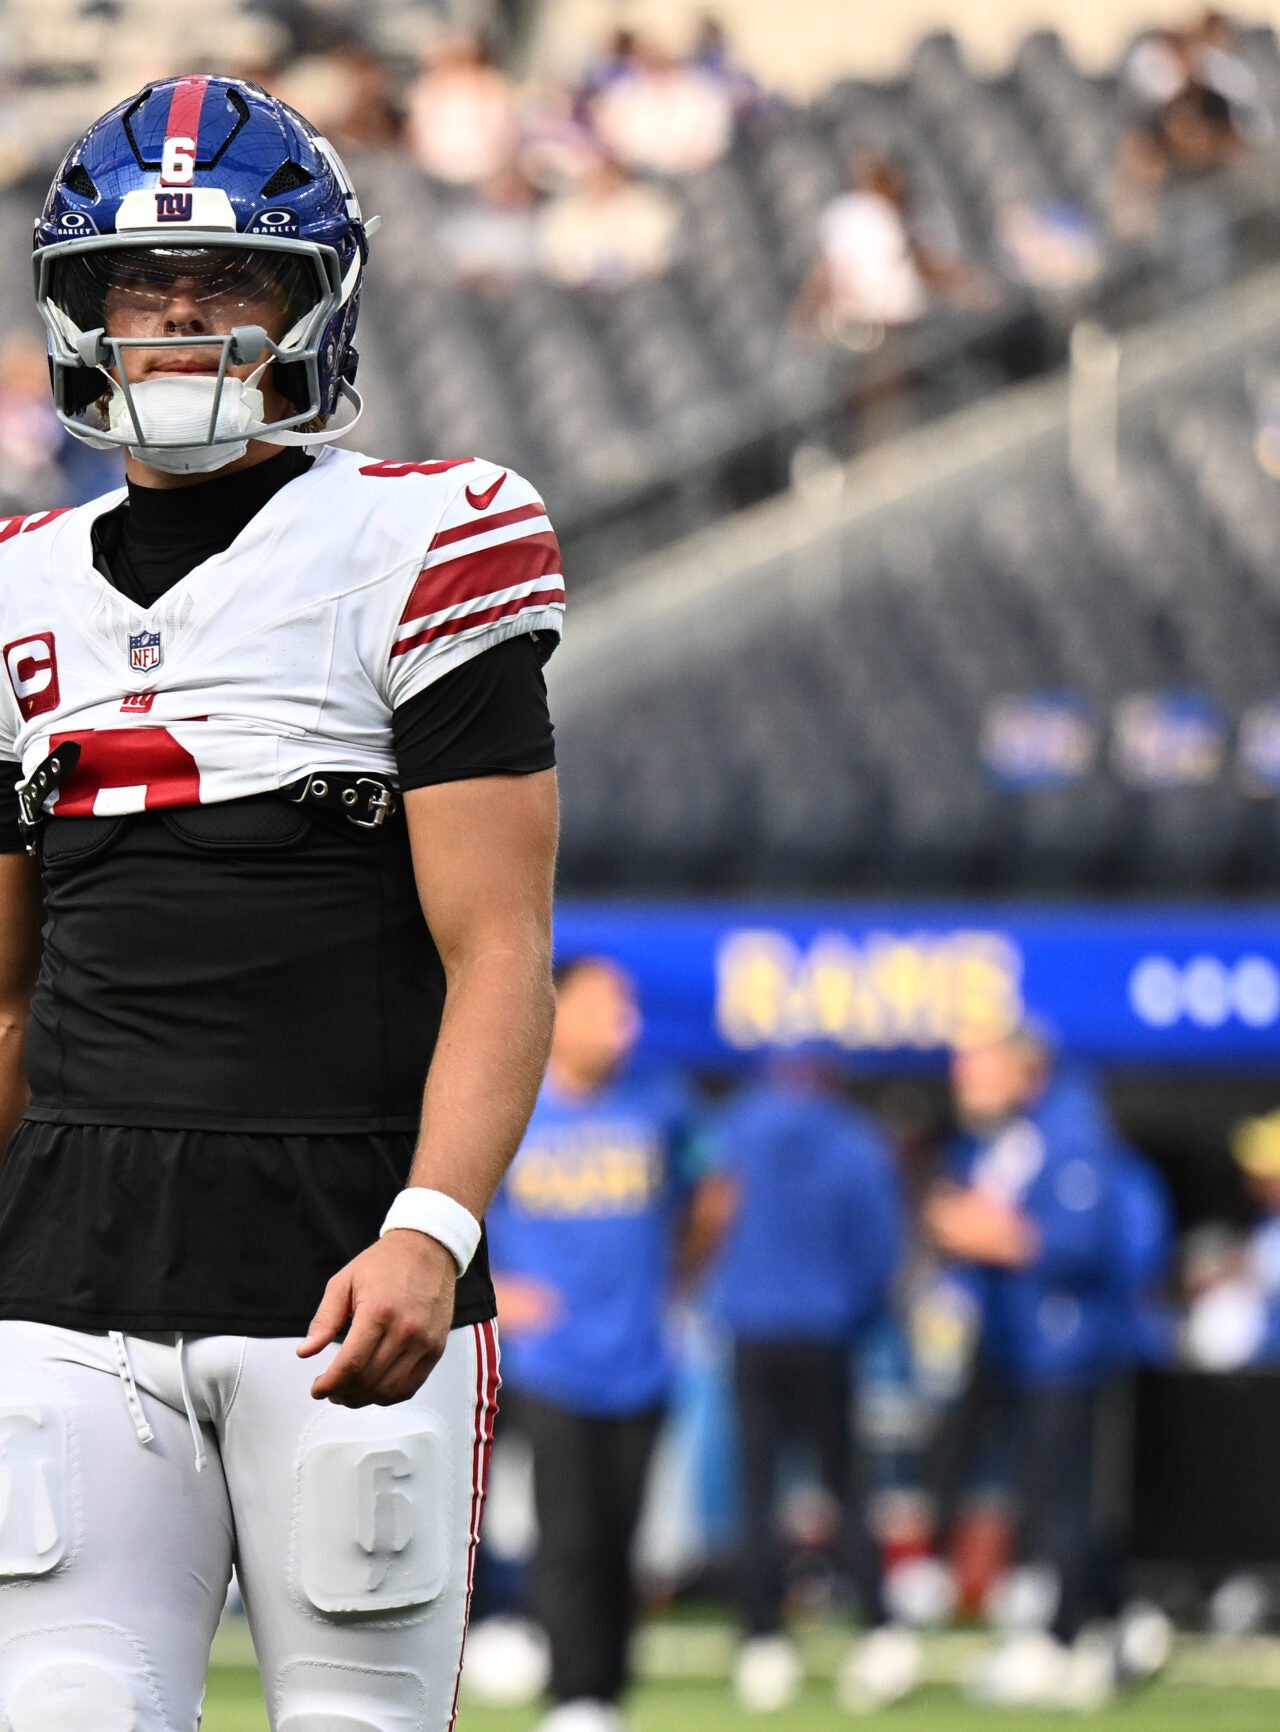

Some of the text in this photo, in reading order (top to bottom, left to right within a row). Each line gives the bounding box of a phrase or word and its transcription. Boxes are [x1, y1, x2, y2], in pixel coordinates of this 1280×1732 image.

[161, 137, 195, 184] 6
[253, 225, 297, 234] OAKLEY
[7, 639, 53, 699] C
[132, 647, 158, 668] NFL
[355, 1449, 412, 1555] 6
